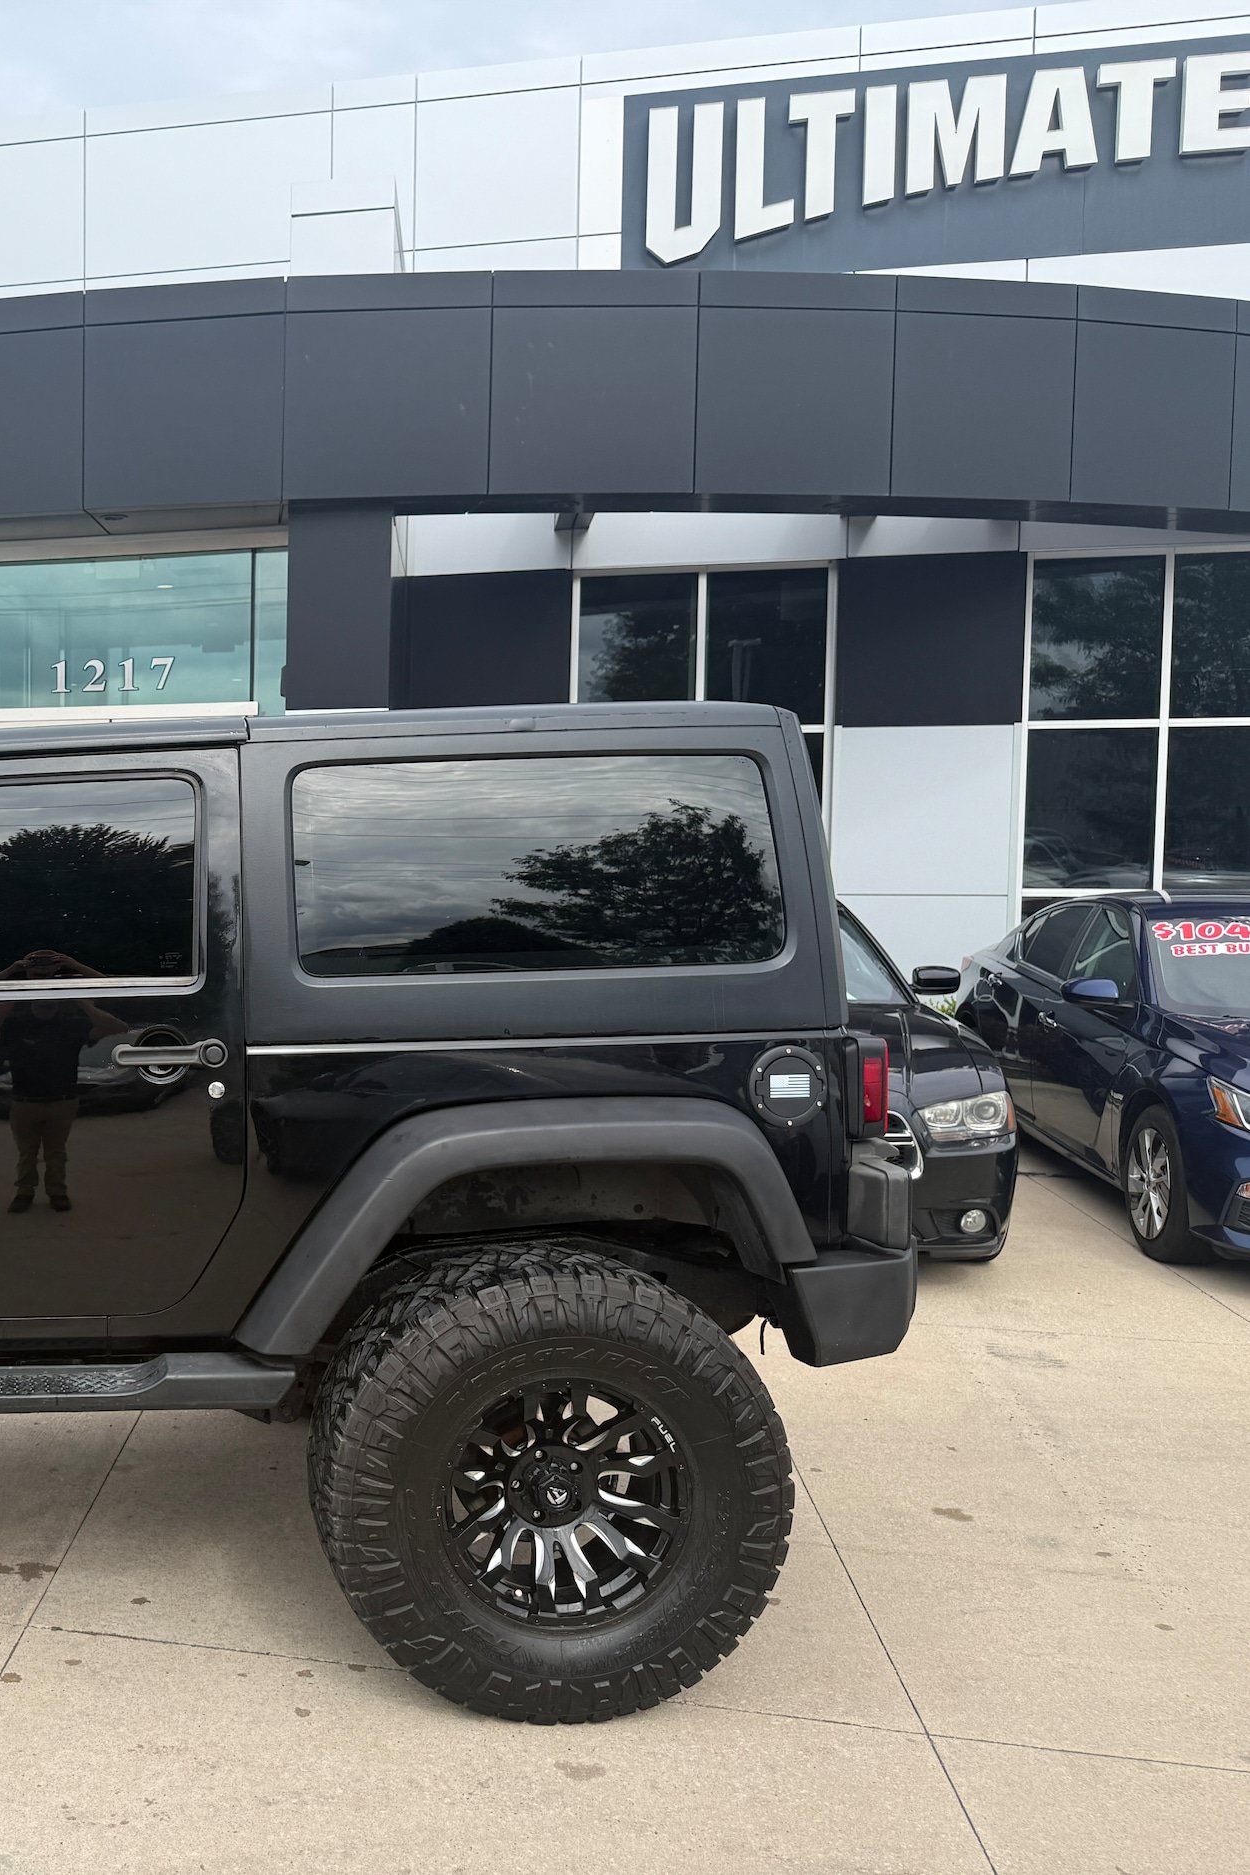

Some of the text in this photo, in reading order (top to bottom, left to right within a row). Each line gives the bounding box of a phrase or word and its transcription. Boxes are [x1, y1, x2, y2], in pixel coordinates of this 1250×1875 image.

[645, 51, 1250, 266] ULTIMATE
[50, 656, 175, 694] 1217
[1152, 922, 1250, 941] $104
[1171, 944, 1219, 957] BEST
[650, 1416, 677, 1453] FUEL
